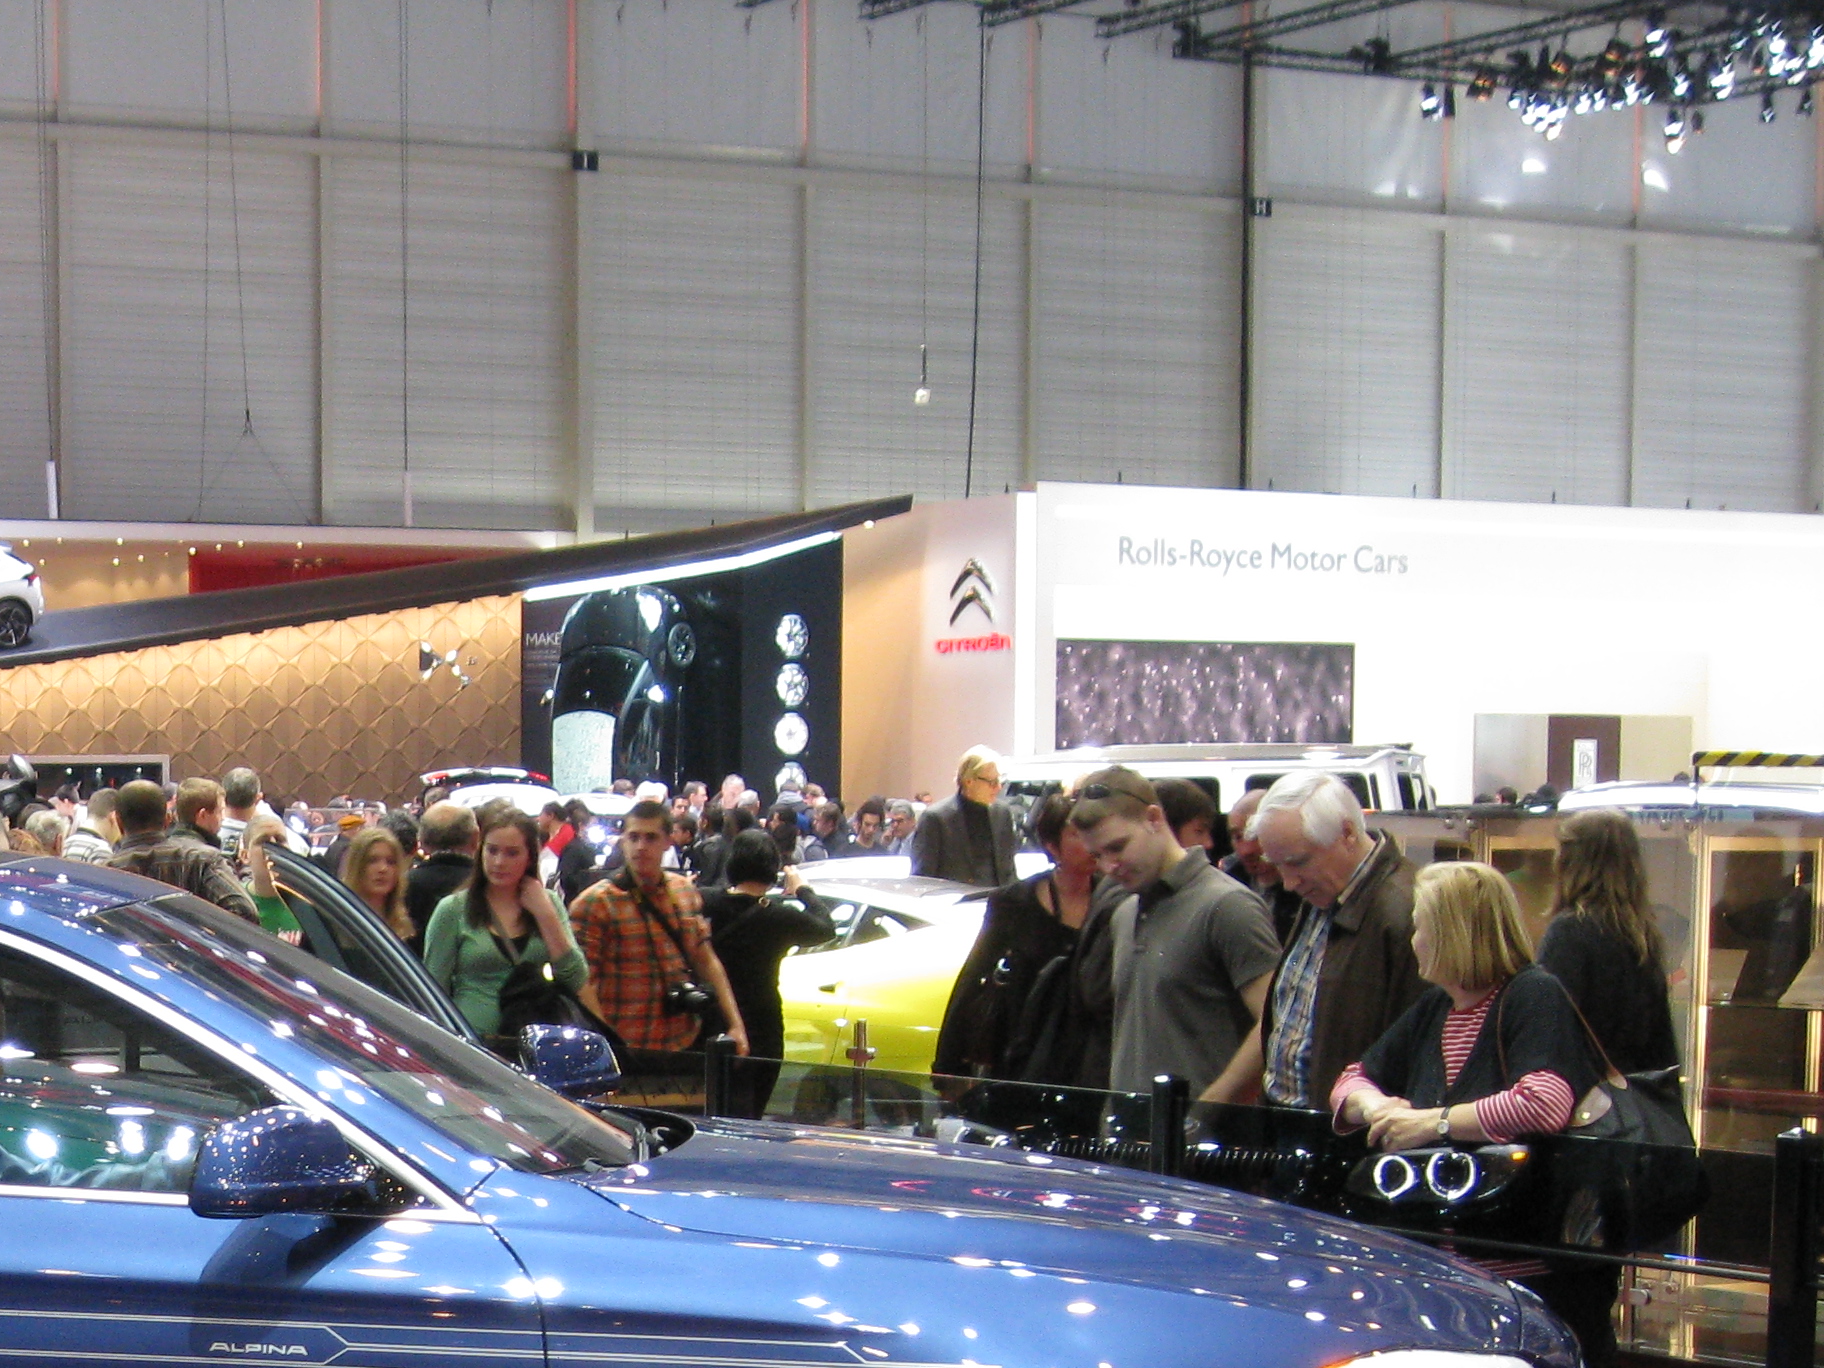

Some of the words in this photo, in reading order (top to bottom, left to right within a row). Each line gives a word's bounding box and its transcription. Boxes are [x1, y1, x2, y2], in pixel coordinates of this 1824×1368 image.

[1255, 199, 1267, 214] H
[1118, 535, 1263, 578] Rolls-Royce
[1270, 541, 1348, 573] Motor
[1353, 544, 1409, 575] Cars
[208, 1341, 309, 1357] ALPINA
